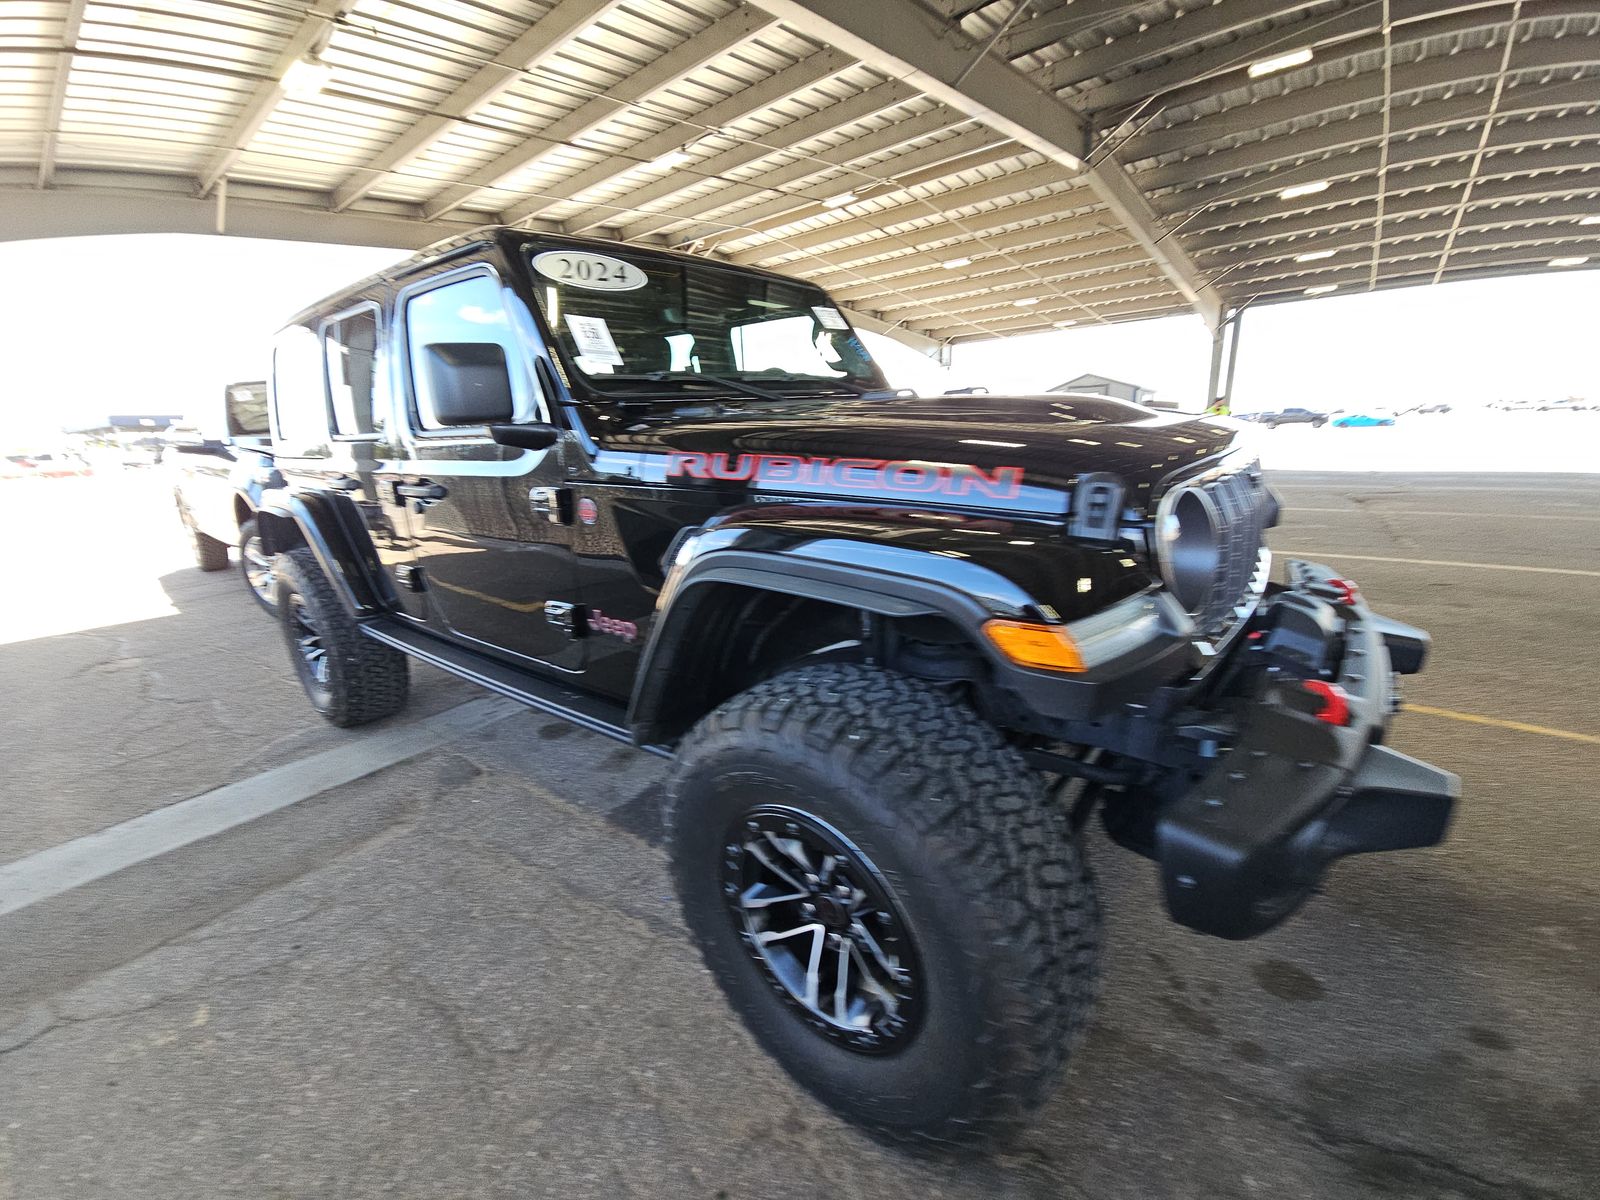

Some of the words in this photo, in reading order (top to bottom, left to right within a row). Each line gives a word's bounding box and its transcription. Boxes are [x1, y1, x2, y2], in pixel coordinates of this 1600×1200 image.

[558, 258, 628, 283] 2024
[668, 451, 1024, 499] RUBICON
[587, 609, 637, 640] Jeep
